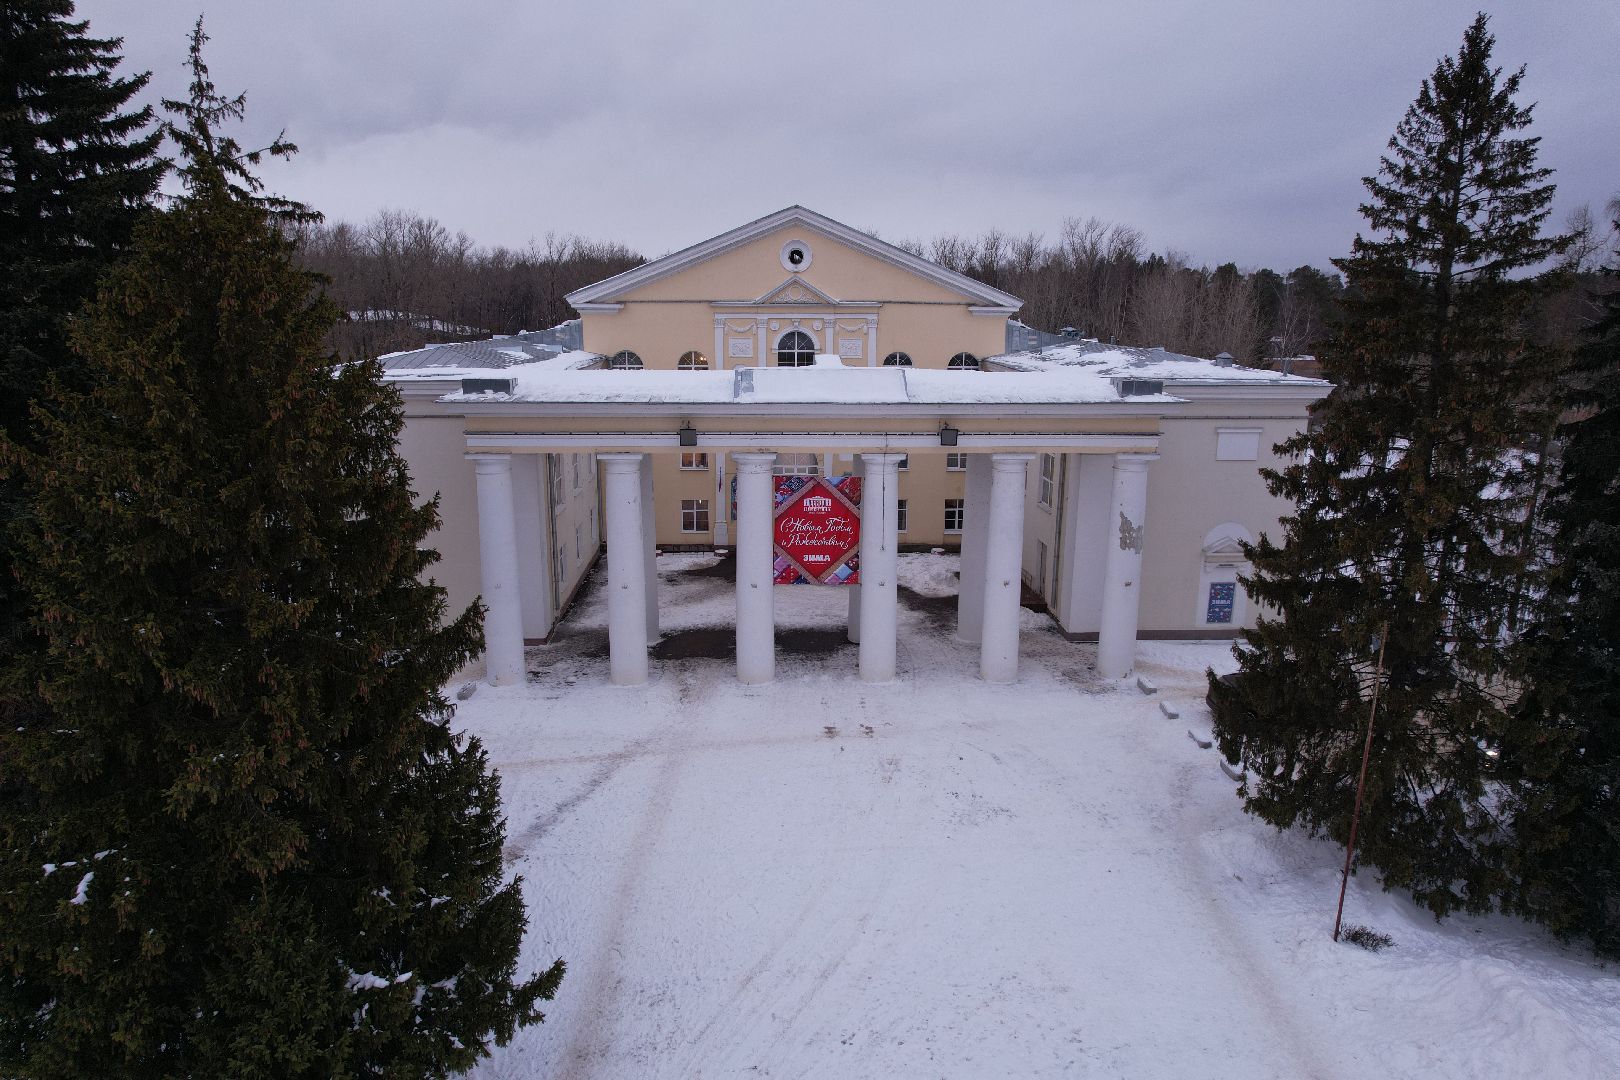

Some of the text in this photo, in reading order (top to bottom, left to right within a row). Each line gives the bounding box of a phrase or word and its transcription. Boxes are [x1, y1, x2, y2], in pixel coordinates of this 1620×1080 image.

[788, 518, 824, 534] Новым
[824, 517, 854, 534] Годом
[803, 554, 831, 562] ЗИМА
